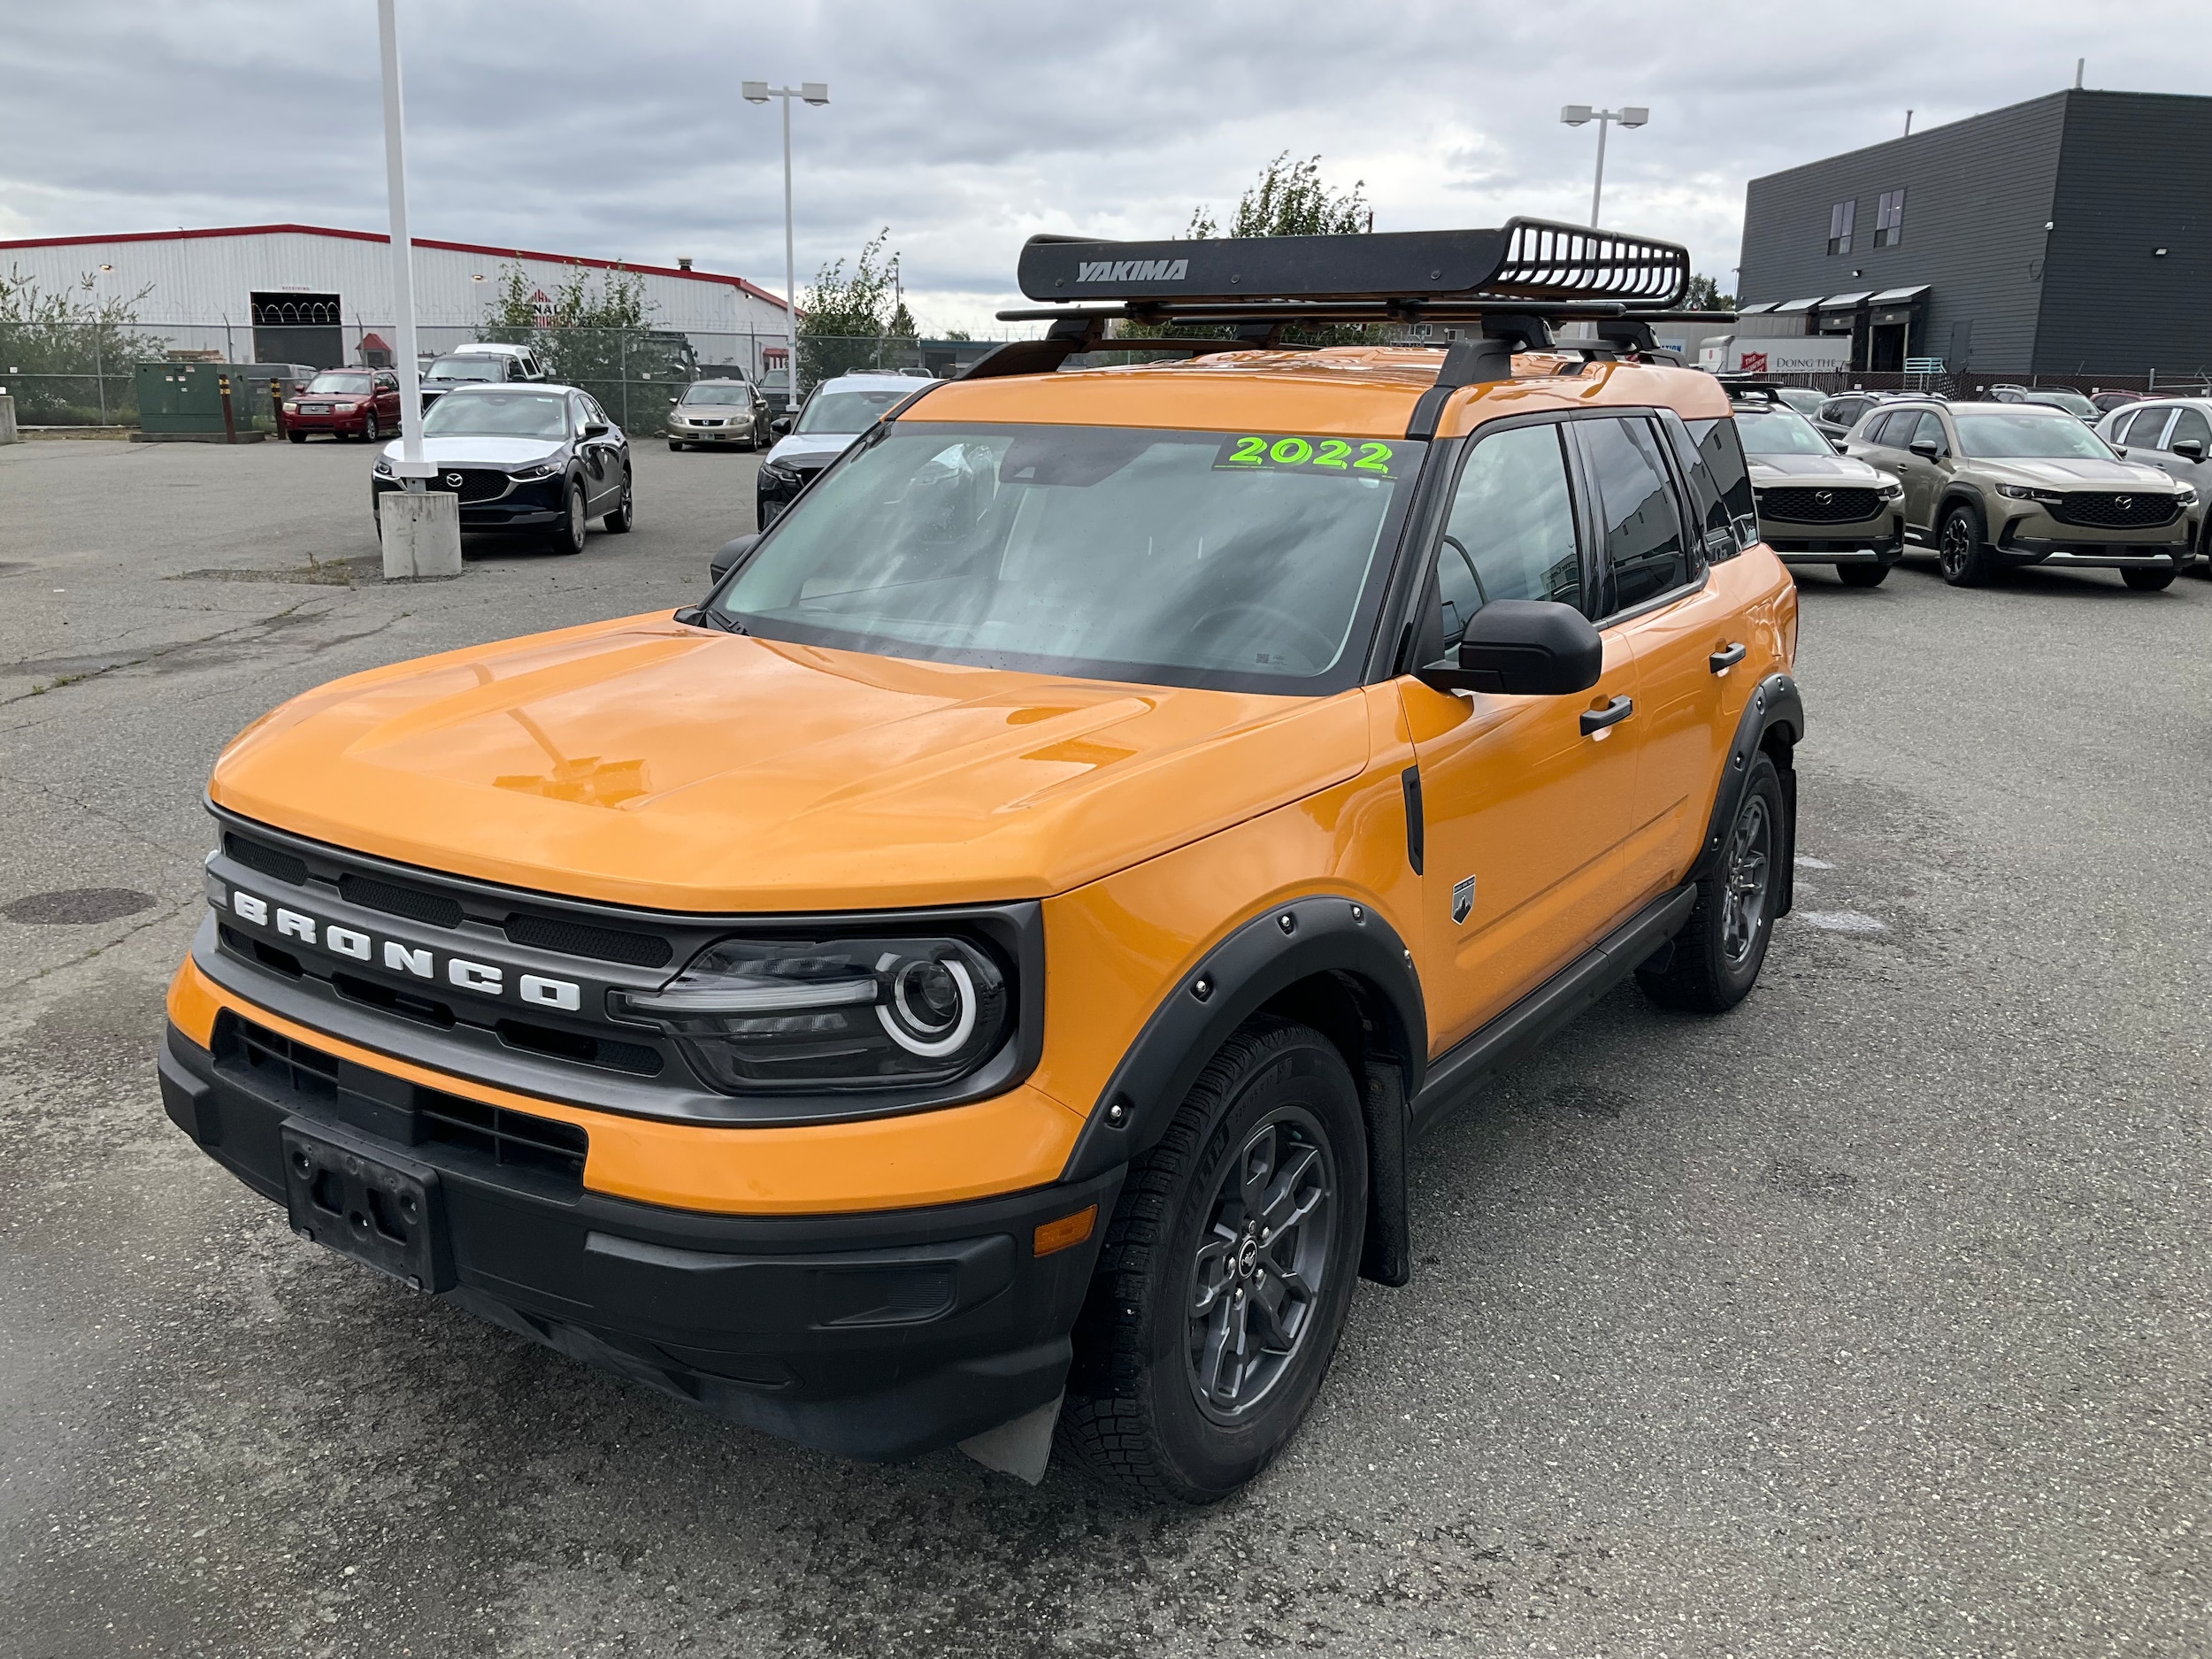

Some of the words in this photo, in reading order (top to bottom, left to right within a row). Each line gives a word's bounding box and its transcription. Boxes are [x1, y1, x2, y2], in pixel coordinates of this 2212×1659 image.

[1076, 259, 1189, 282] YAKIMA
[1745, 354, 1756, 365] THE
[1776, 357, 1814, 368] DOING
[1816, 357, 1838, 368] THE
[1228, 436, 1394, 474] 2022
[234, 890, 581, 1011] BRONCO
